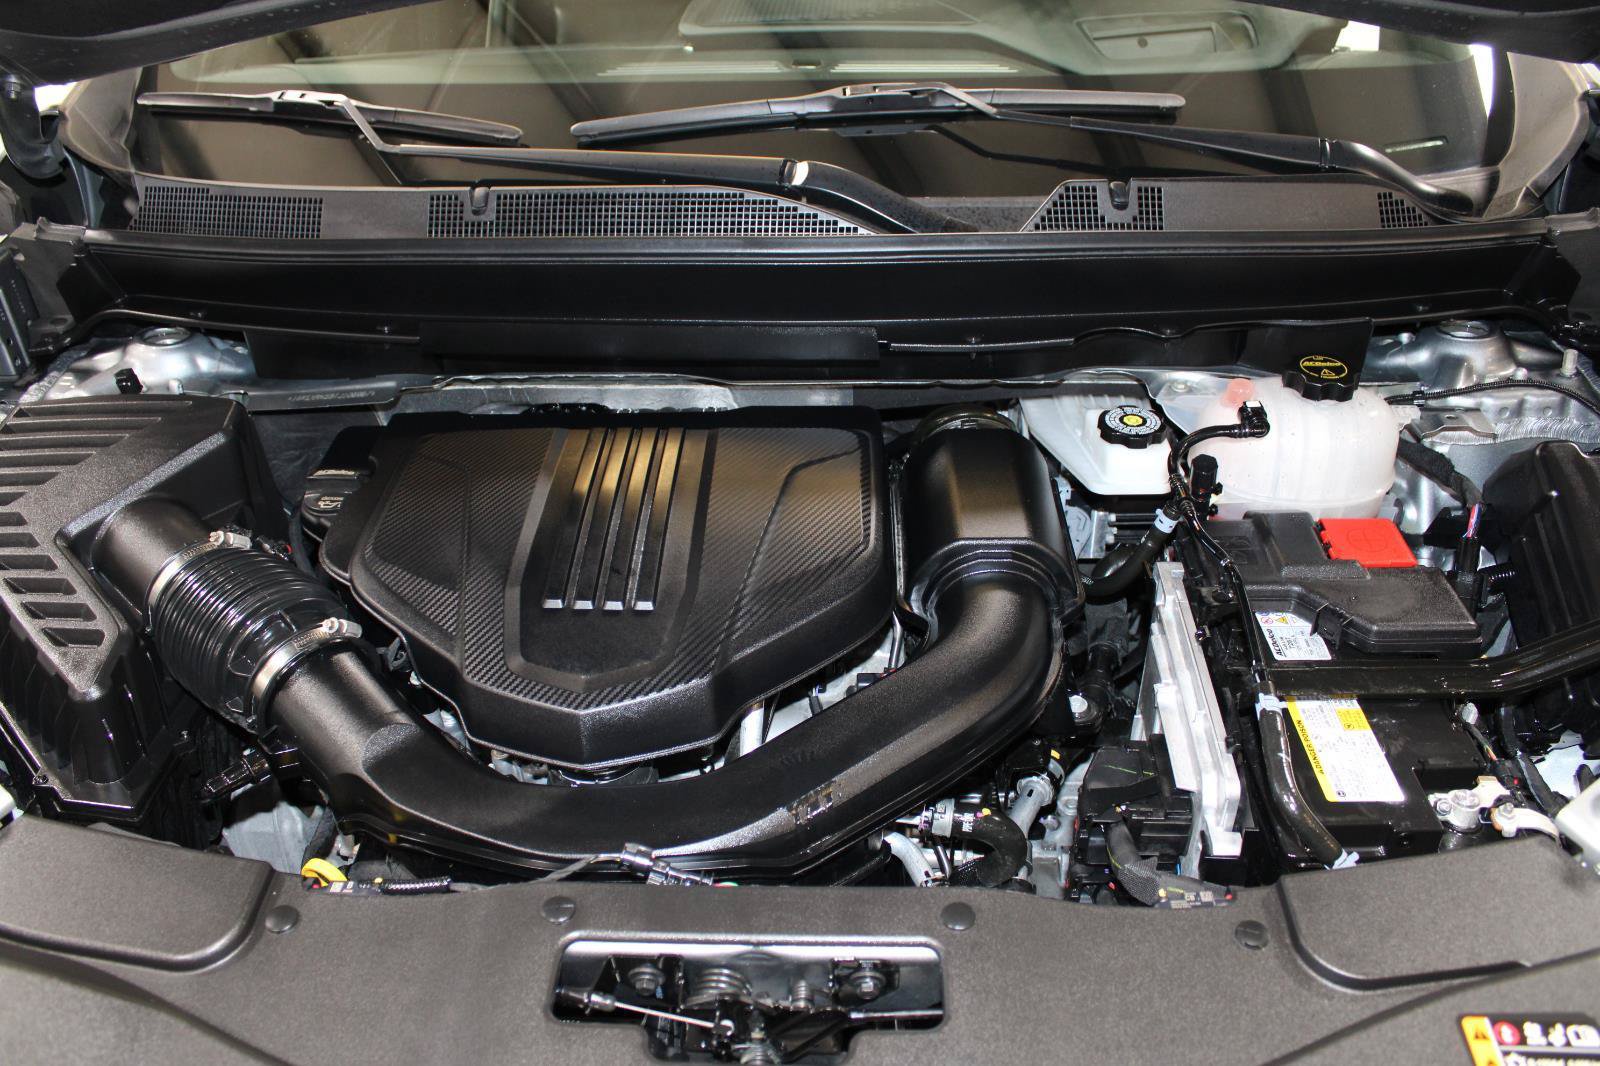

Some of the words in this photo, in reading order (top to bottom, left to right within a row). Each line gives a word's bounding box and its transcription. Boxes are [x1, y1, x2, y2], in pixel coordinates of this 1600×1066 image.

[1266, 628, 1283, 656] ACDelco
[1296, 719, 1311, 742] POISON
[1304, 741, 1323, 769] DANGER
